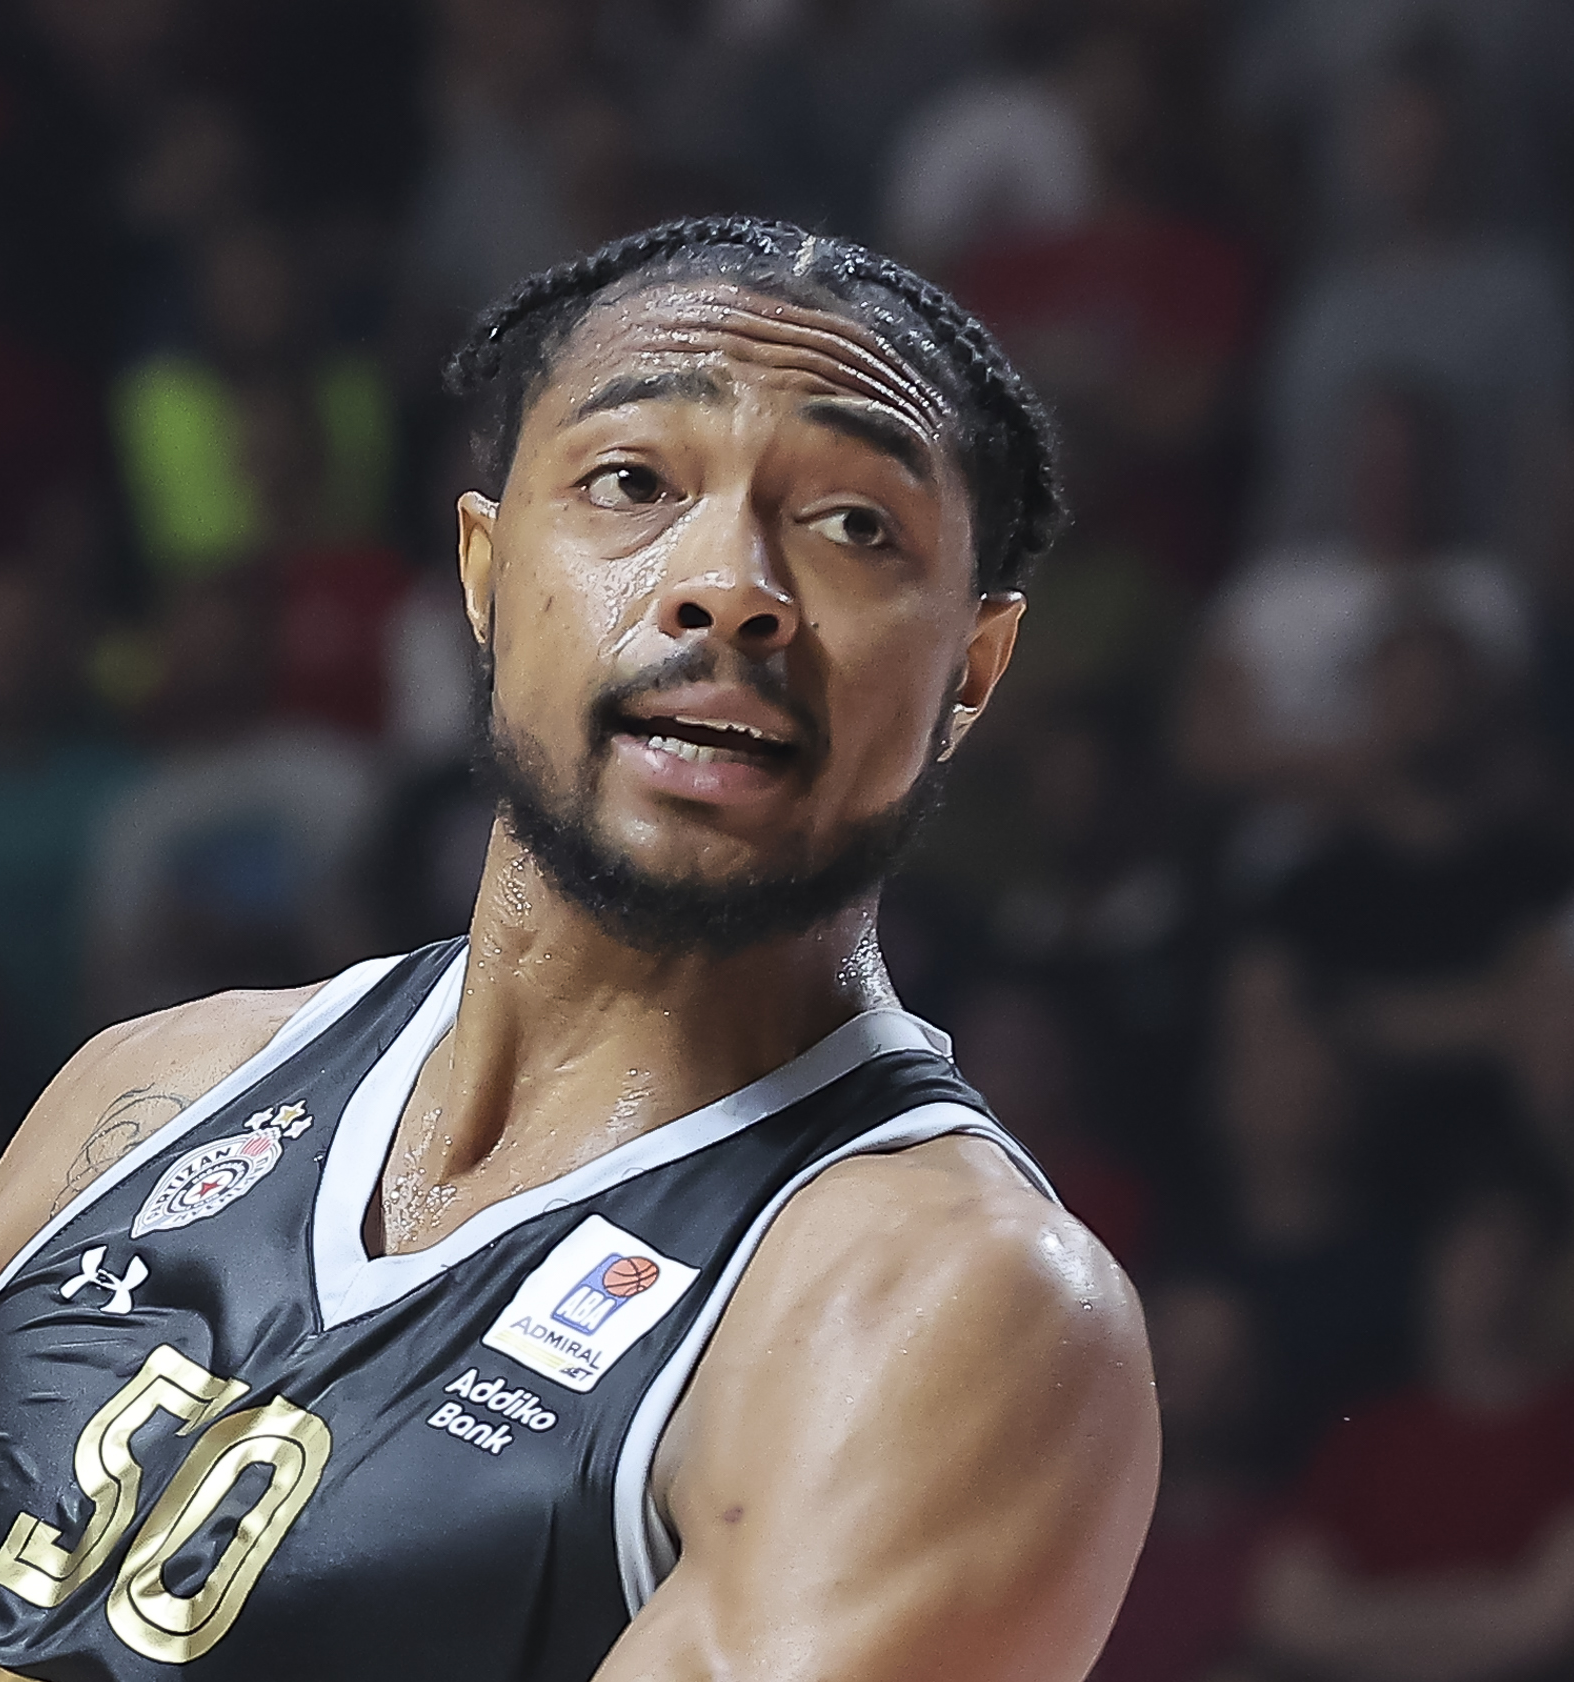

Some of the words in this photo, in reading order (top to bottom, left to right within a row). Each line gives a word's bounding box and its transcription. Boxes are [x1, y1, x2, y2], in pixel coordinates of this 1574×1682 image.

[556, 1284, 618, 1330] ABA
[510, 1316, 604, 1370] ADMIRAL
[445, 1368, 557, 1430] Addiko
[427, 1402, 513, 1455] Bank
